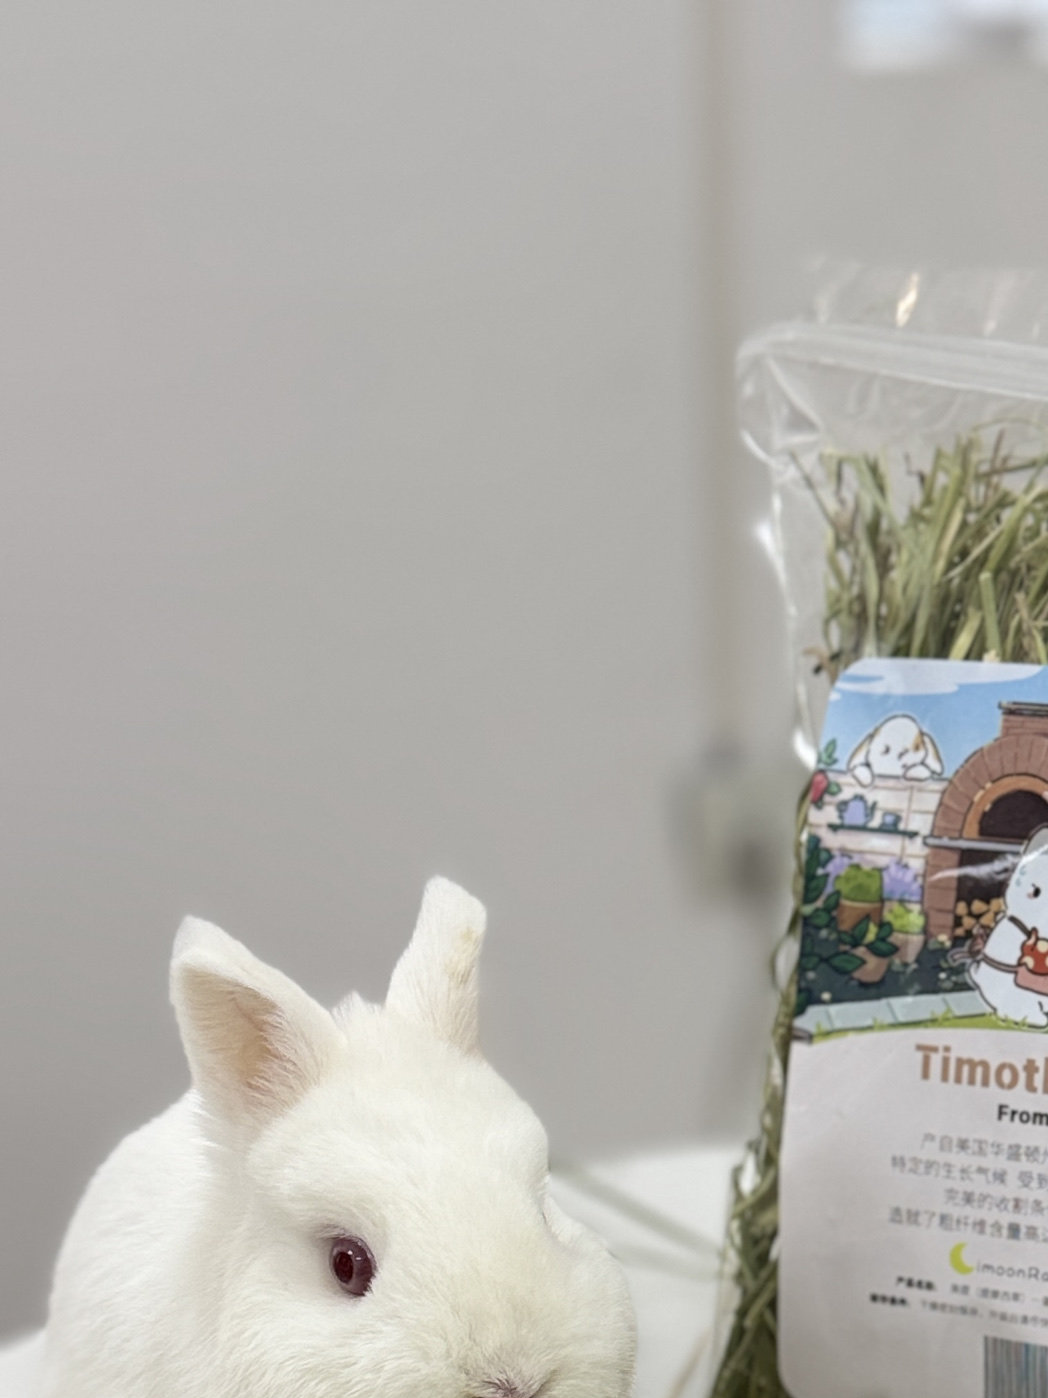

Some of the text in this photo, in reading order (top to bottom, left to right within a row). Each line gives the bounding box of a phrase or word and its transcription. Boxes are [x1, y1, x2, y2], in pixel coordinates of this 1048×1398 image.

[891, 1155, 1008, 1187] 特定的生长气候
